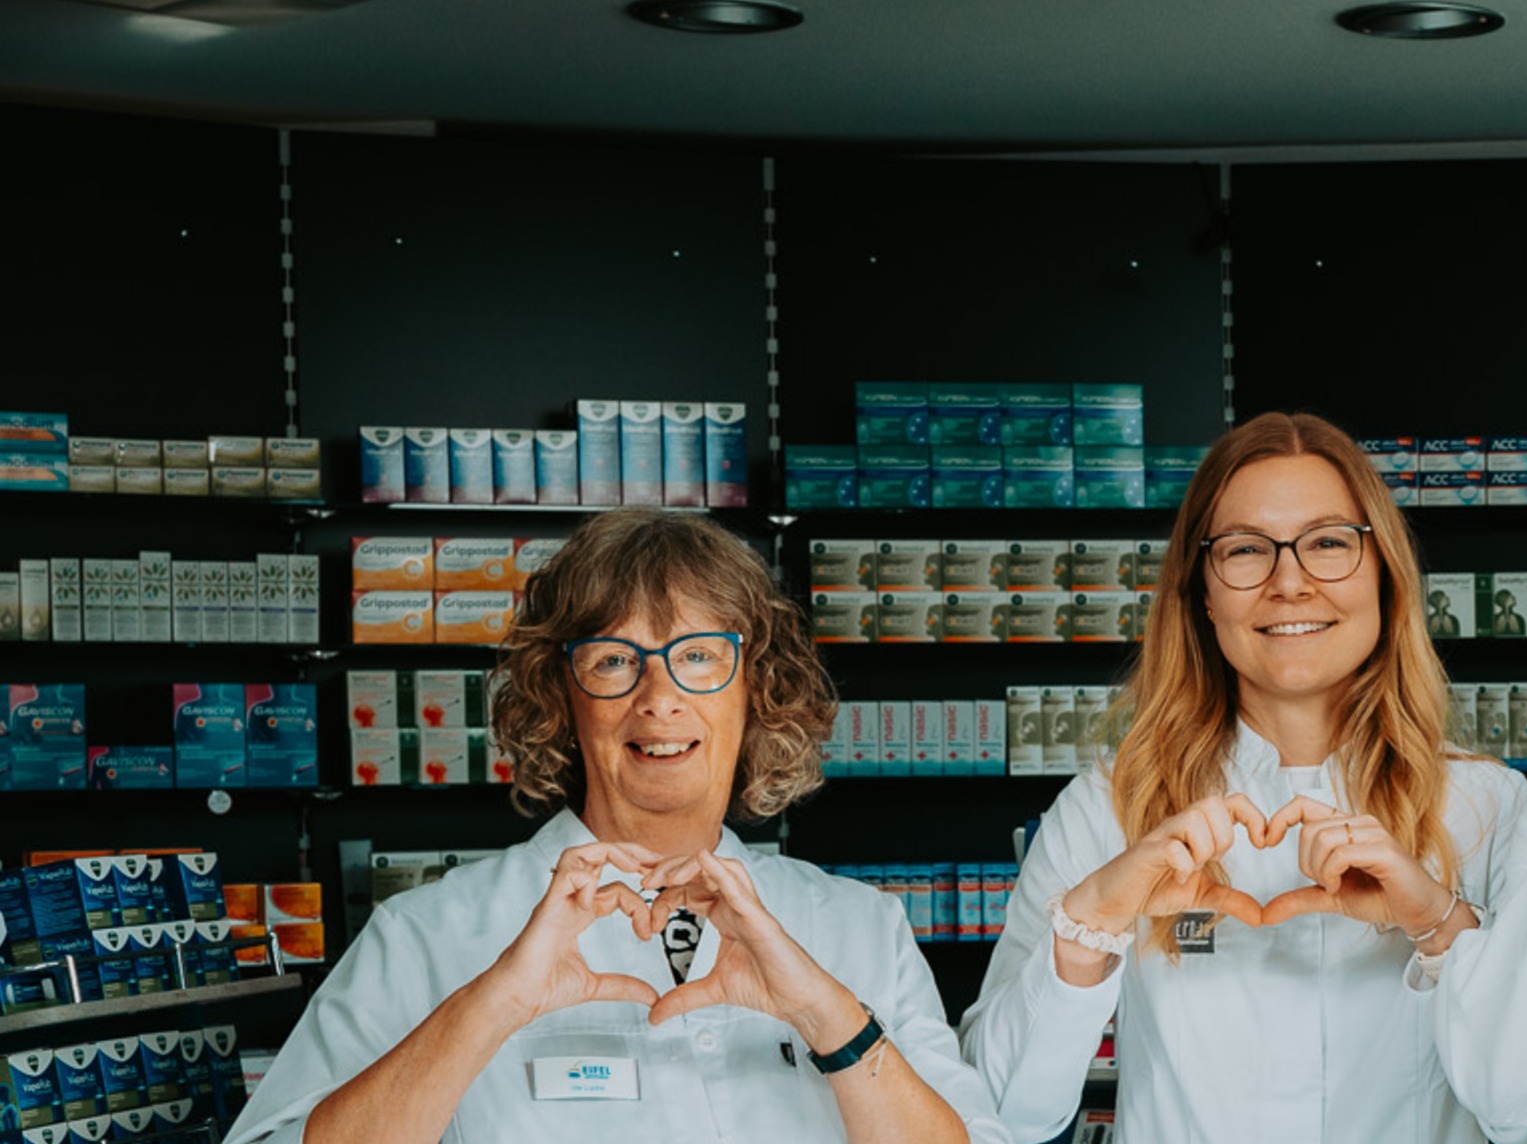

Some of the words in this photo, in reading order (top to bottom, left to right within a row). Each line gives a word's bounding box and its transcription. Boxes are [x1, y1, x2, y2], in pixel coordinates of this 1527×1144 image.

[1, 416, 54, 429] modium
[1358, 440, 1380, 451] ACC
[1424, 440, 1449, 451] ACC
[1491, 439, 1517, 450] ACC
[1, 456, 54, 469] modium
[1424, 474, 1449, 485] ACC
[1491, 474, 1517, 484] ACC
[360, 544, 428, 556] Grippostad
[442, 545, 509, 557] Grippostad
[360, 597, 428, 609] Grippostad
[442, 598, 509, 610] Grippostad
[17, 705, 75, 716] GAVISCON
[853, 705, 861, 741] nasic
[884, 705, 893, 741] nasic
[916, 704, 924, 741] nasic
[947, 704, 956, 741] nasic
[979, 704, 988, 740] nasic
[95, 755, 156, 768] GAVISCON
[582, 1065, 611, 1075] EIFEL
